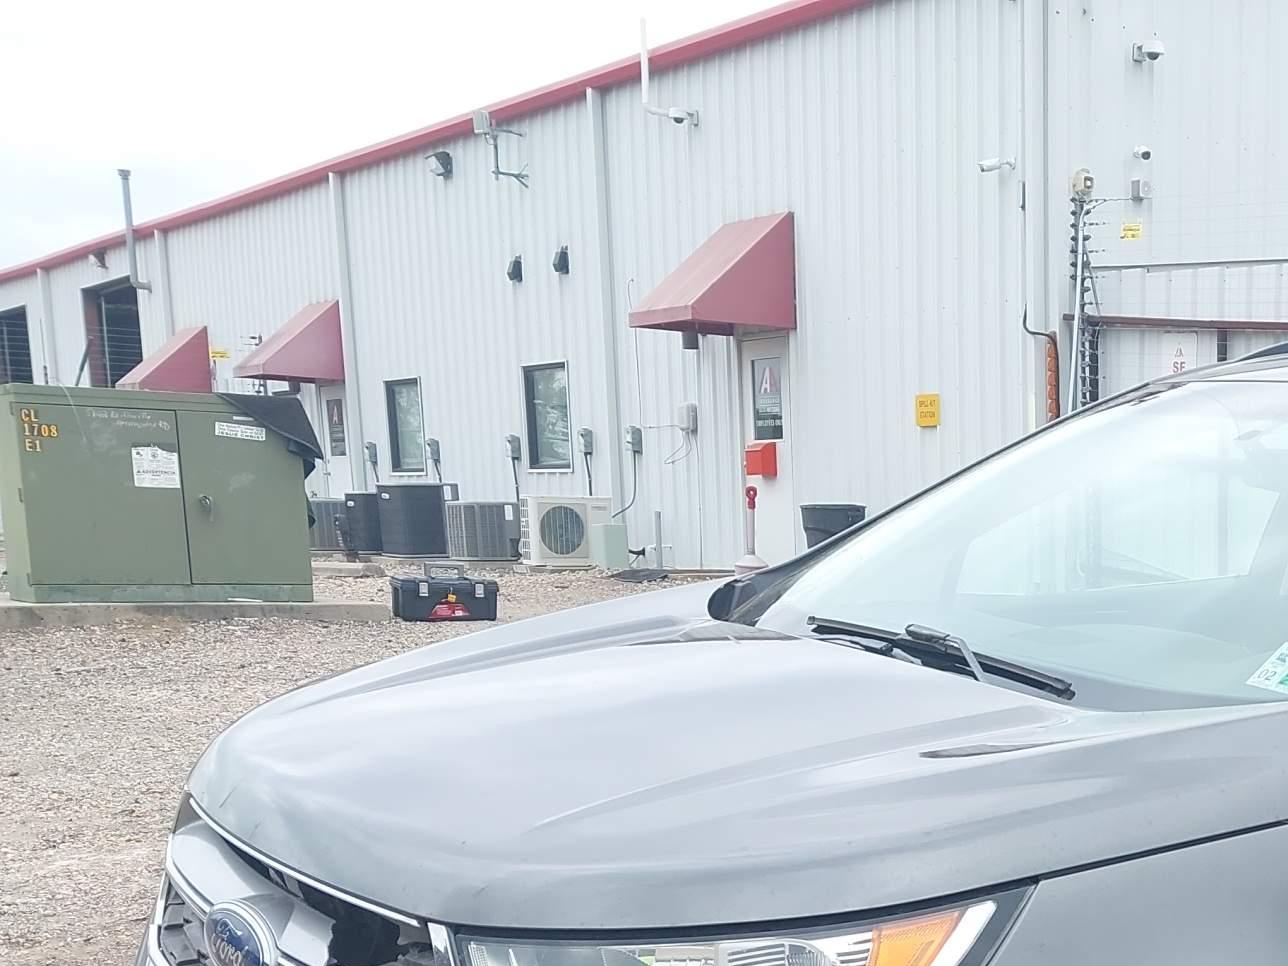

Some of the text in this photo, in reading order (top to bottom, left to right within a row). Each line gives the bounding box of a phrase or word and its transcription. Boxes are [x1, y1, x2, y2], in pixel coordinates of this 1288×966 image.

[20, 408, 39, 421] CL
[23, 423, 58, 437] 1708
[25, 438, 41, 452] E1
[1257, 668, 1277, 681] 02
